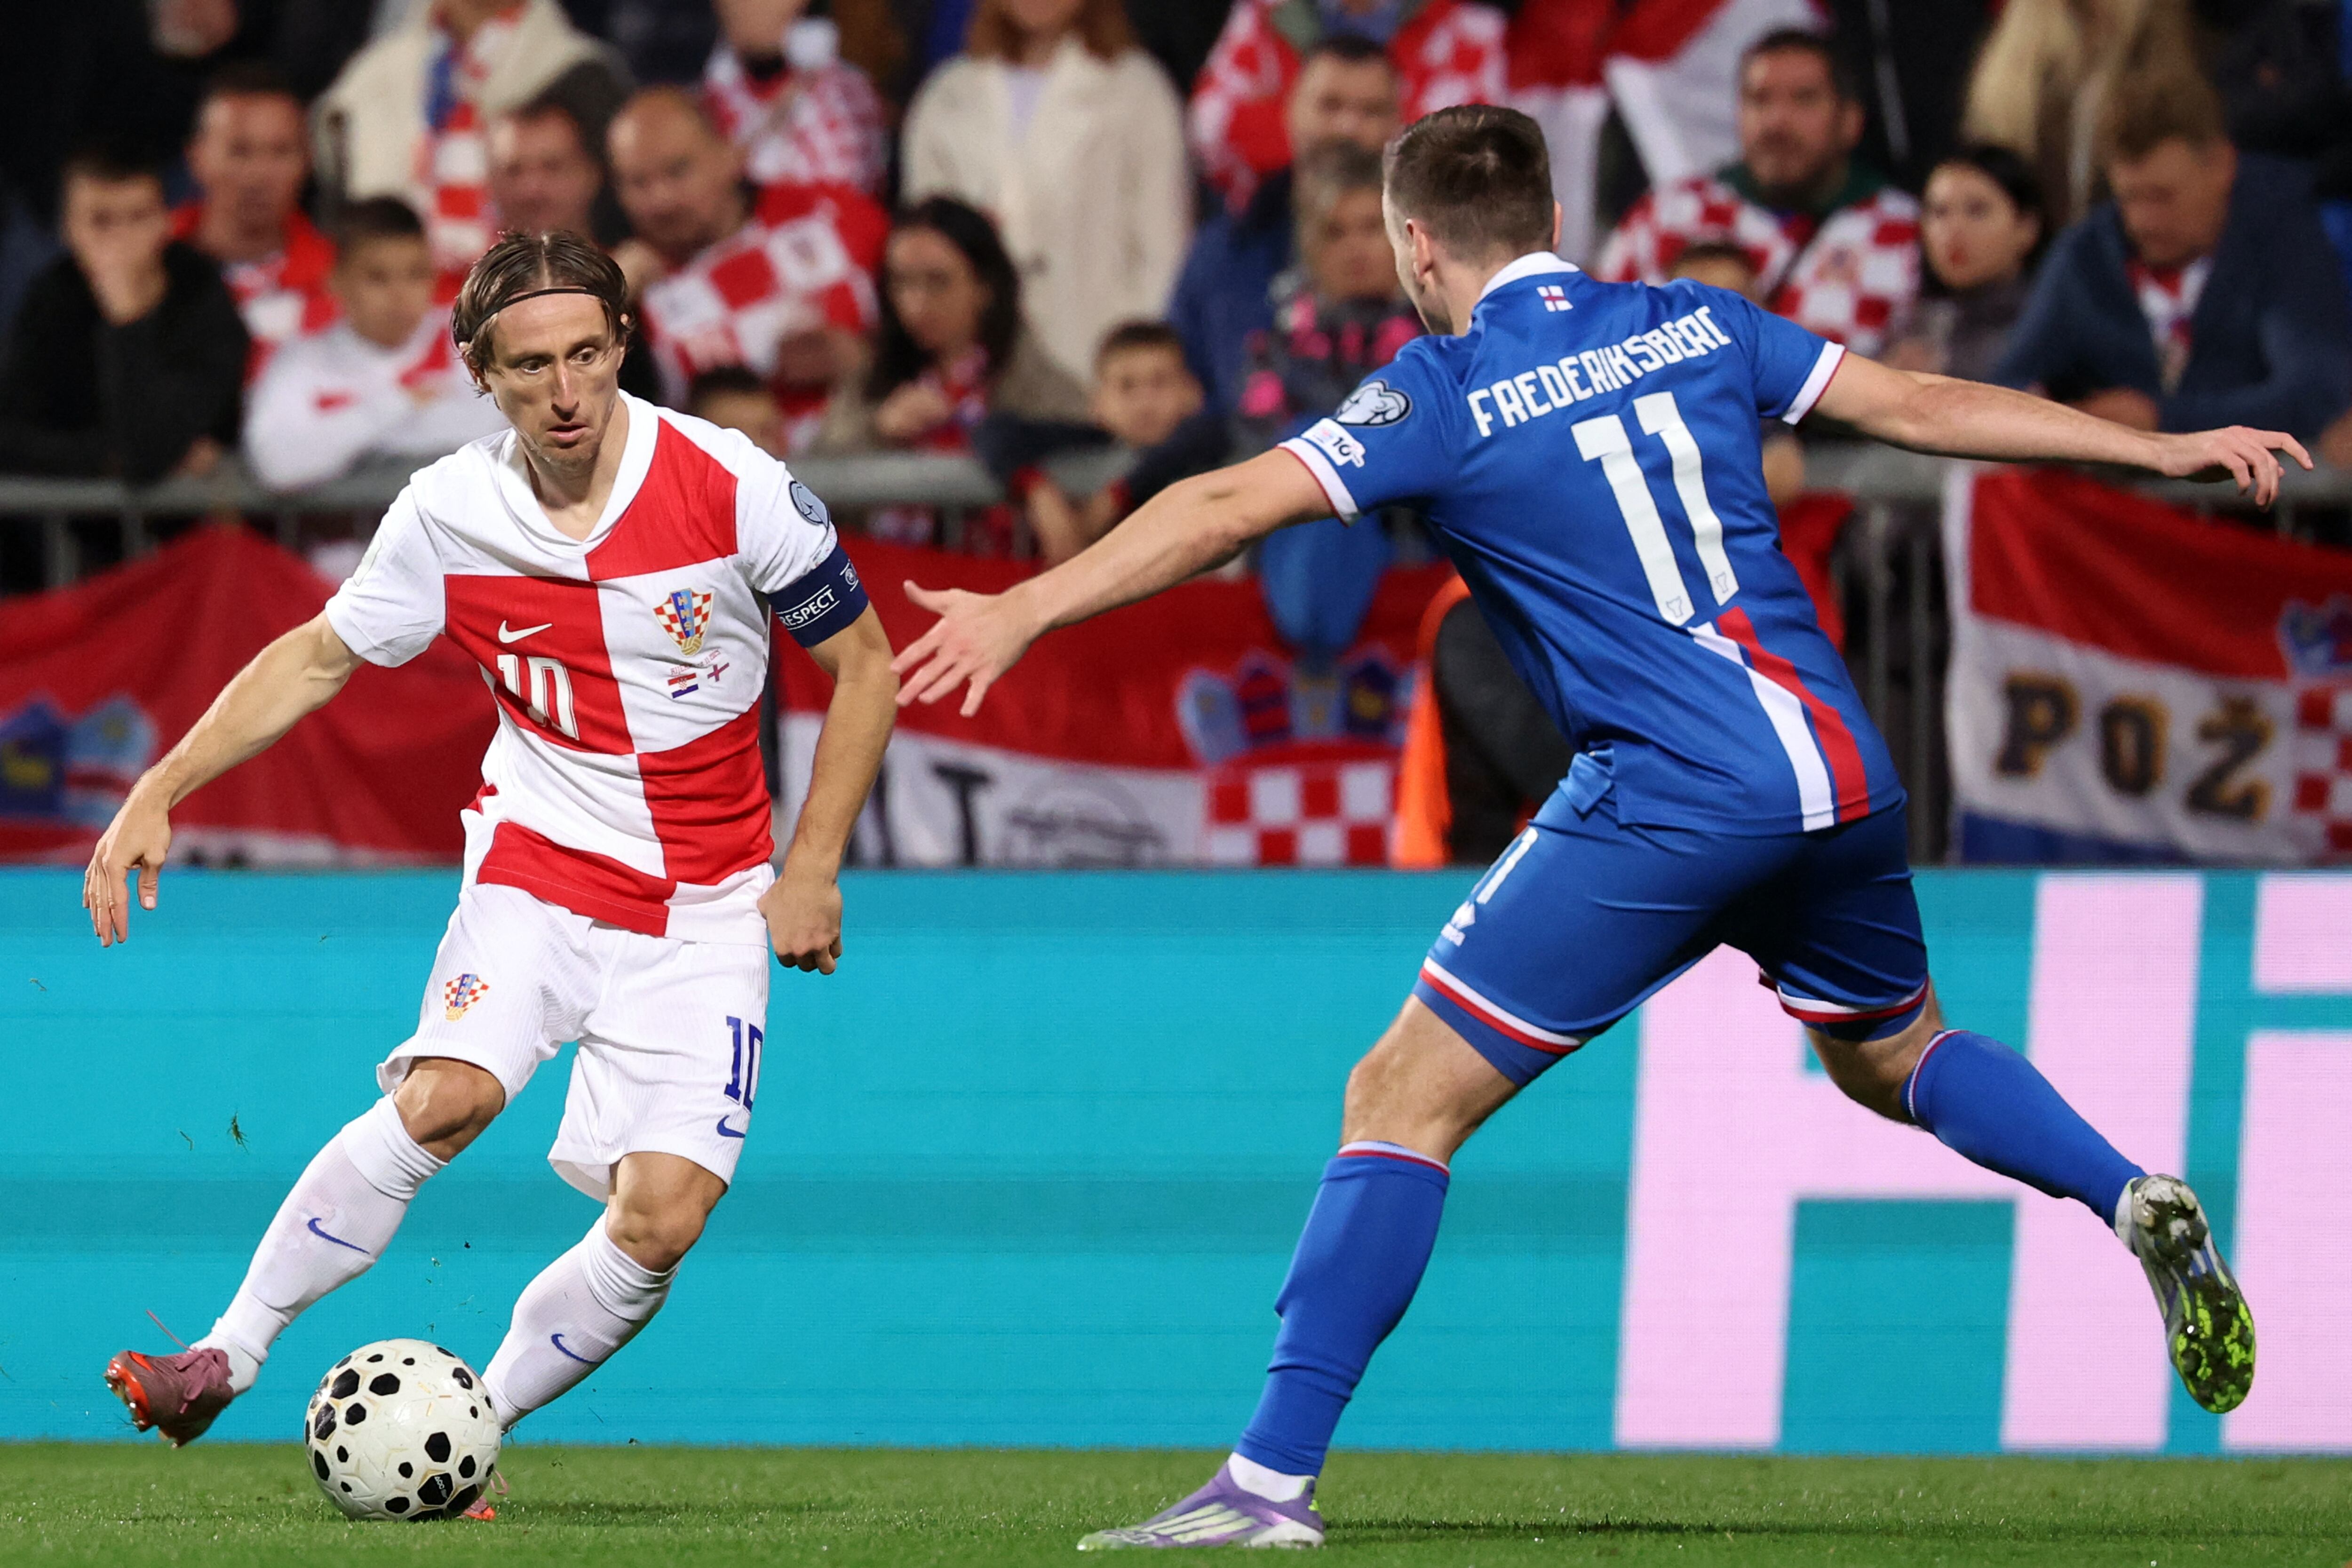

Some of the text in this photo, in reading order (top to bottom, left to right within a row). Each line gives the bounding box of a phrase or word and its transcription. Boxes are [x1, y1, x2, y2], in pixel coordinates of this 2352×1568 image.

[1571, 391, 1740, 627] 11
[779, 589, 834, 626] RESPECT
[497, 654, 580, 741] 10
[1613, 873, 2352, 1448] Hi
